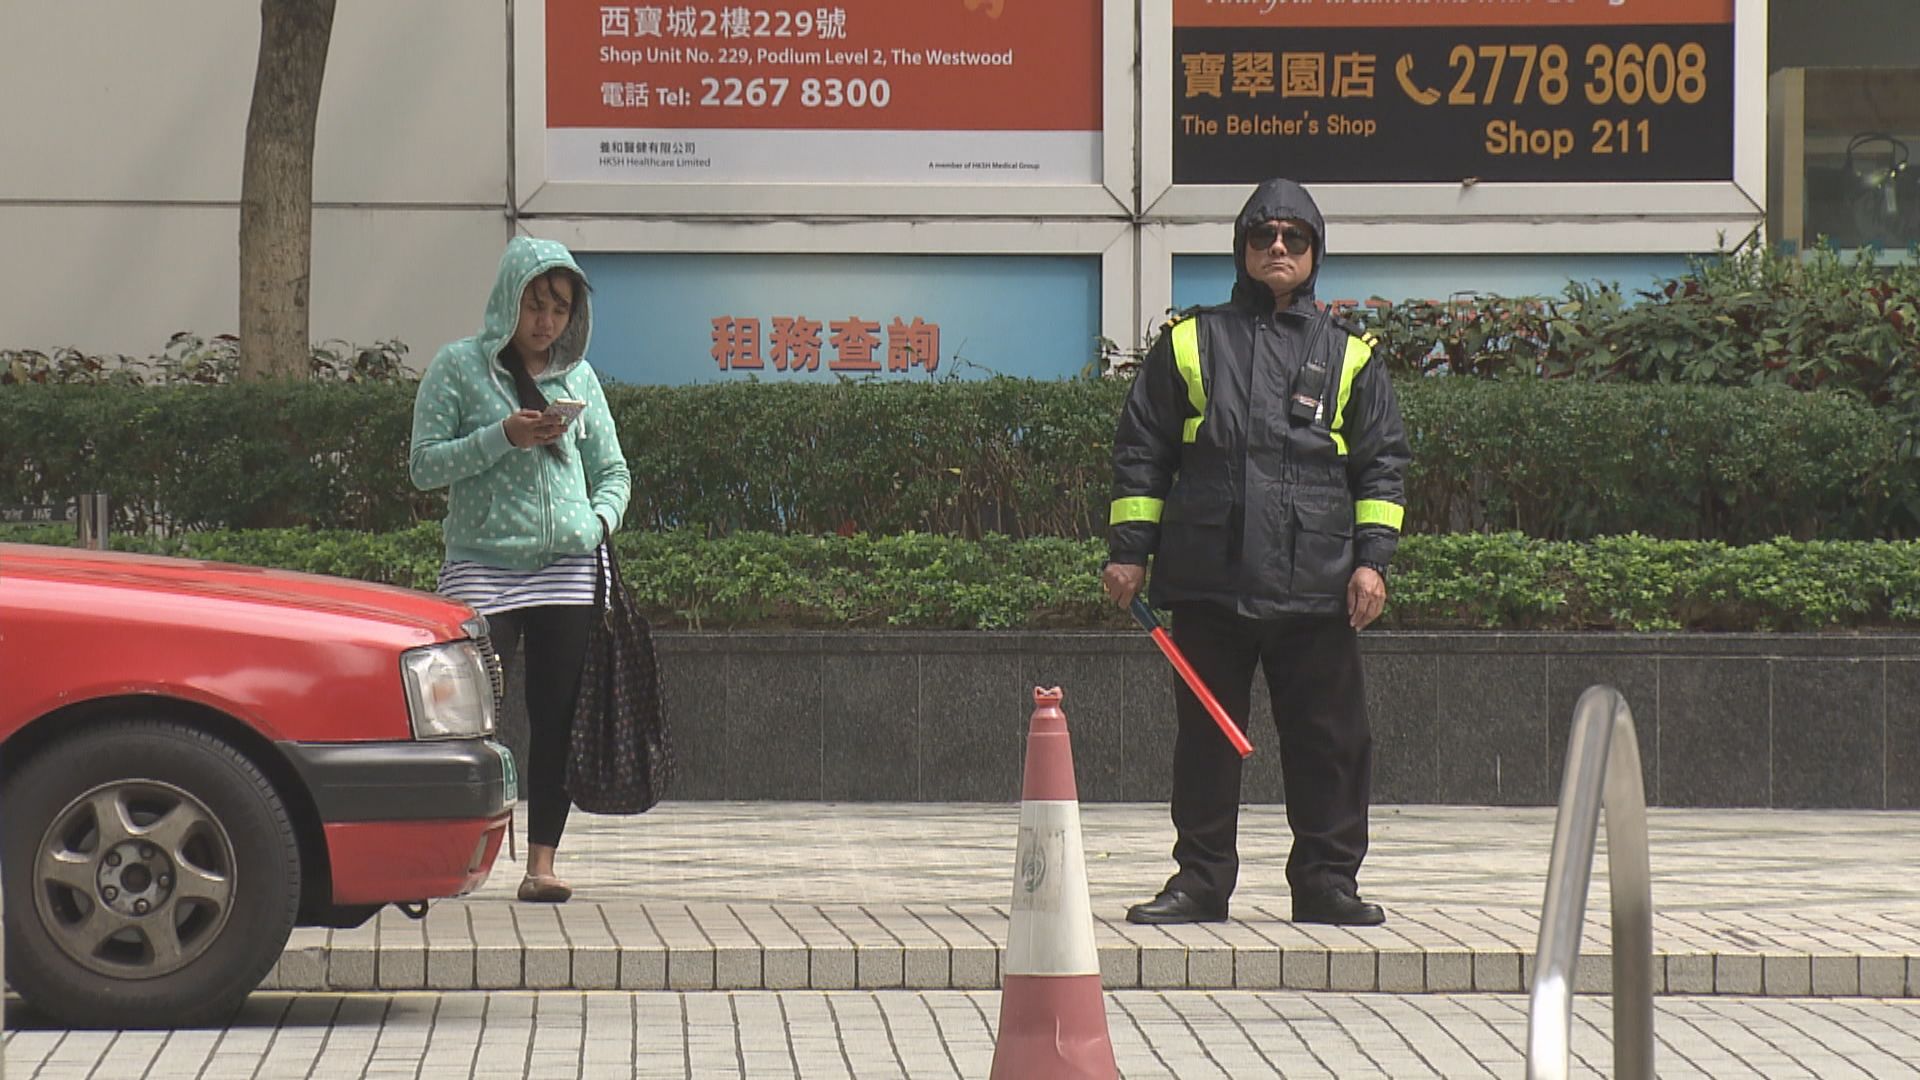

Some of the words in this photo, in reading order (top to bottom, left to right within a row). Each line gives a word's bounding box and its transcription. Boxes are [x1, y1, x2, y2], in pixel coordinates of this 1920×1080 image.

[599, 5, 847, 39] 西寶城2樓229號
[600, 46, 642, 66] Shop
[647, 47, 682, 64] Unit
[686, 47, 714, 63] No.
[718, 48, 753, 66] 229,
[757, 47, 821, 65] Podium
[825, 48, 868, 65] Level
[873, 49, 887, 67] 2,
[891, 48, 922, 65] The
[925, 49, 1013, 65] Westwood
[1181, 52, 1377, 98] 寶翠園店
[1448, 44, 1569, 105] 2778
[1584, 42, 1706, 105] 3608
[600, 82, 649, 108] 電話
[655, 87, 690, 106] Tel:
[700, 78, 789, 106] 2267
[800, 78, 890, 107] 8300
[1181, 115, 1218, 135] The
[1226, 111, 1319, 135] Belcher's
[1327, 114, 1377, 137] Shop
[1485, 119, 1574, 160] Shop
[1591, 119, 1650, 154] 211
[599, 157, 625, 167] HKSH
[626, 157, 675, 167] Healthcare
[676, 158, 711, 168] Limited
[928, 161, 934, 169] A
[963, 161, 972, 169] of
[711, 314, 941, 372] 租務查詢
